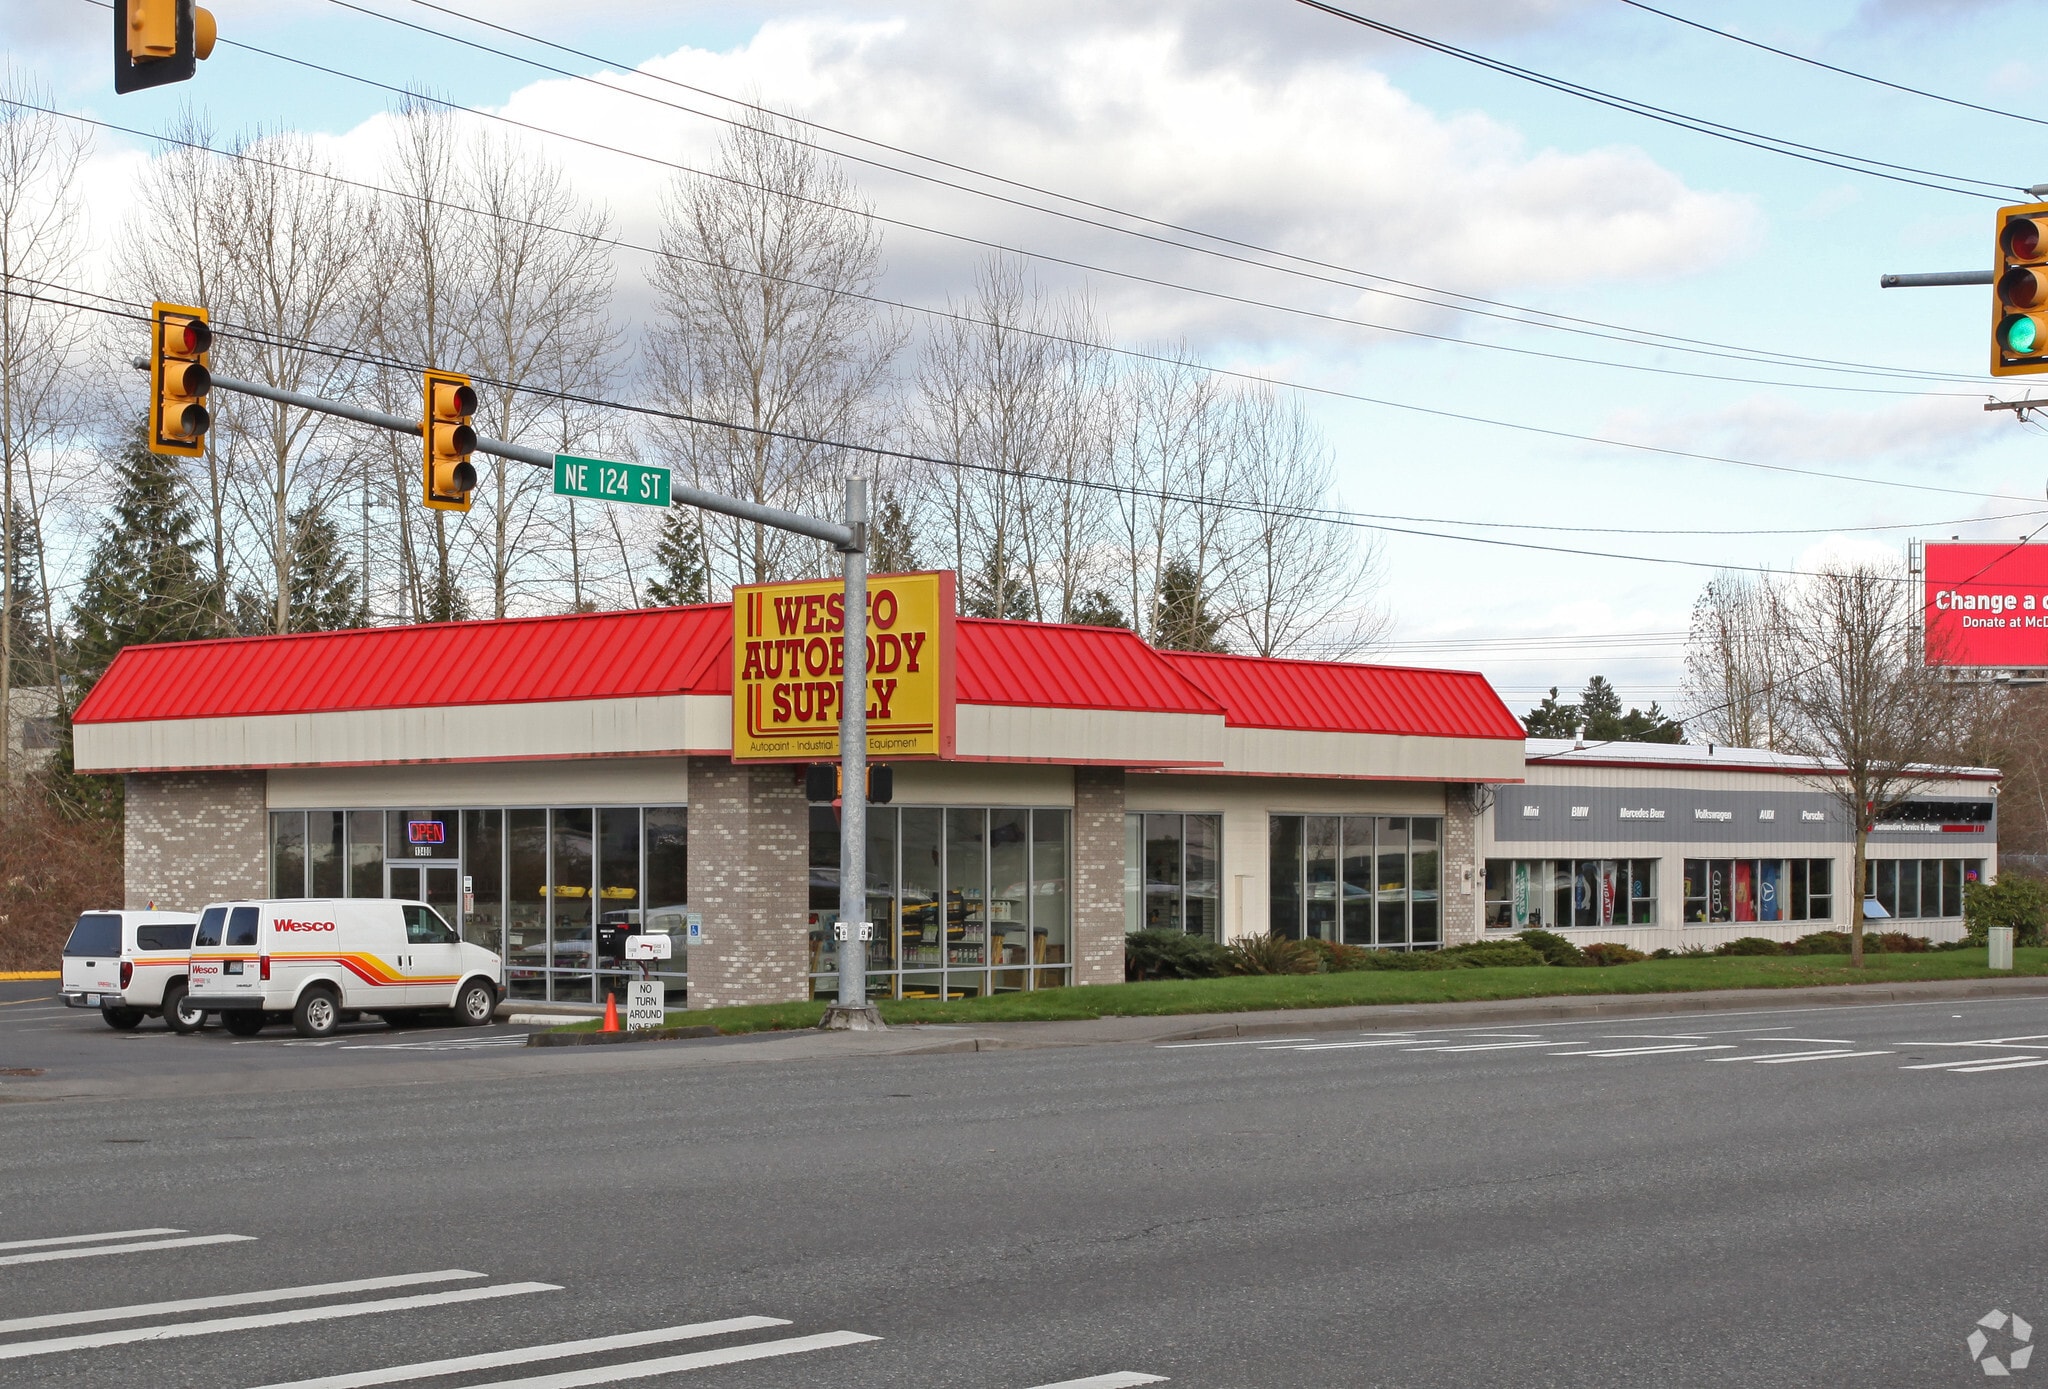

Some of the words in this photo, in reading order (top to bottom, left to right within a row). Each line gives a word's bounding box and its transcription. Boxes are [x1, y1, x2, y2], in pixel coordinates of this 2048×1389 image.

[565, 463, 588, 491] NE
[600, 467, 628, 495] 124
[640, 472, 661, 499] ST
[1936, 590, 2017, 614] Change
[2023, 594, 2035, 610] a
[774, 589, 898, 635] WESO
[1963, 616, 2005, 628] Donate
[2010, 616, 2021, 628] at
[750, 741, 790, 753] Autopaint
[797, 739, 833, 750] Industrial
[870, 737, 917, 749] Equipment
[1523, 806, 1540, 817] Mini
[1571, 806, 1590, 817] BMW
[1620, 807, 1649, 818] Mercedes
[1650, 808, 1665, 819] Benz
[1695, 809, 1732, 821] Volkswagen
[1802, 810, 1825, 821] Porsche
[410, 823, 442, 842] OPEN
[1874, 823, 1901, 831] Automotive
[1902, 823, 1920, 831] Service
[1925, 823, 1940, 833] Repair
[274, 919, 335, 932] Wesco
[192, 965, 218, 974] Wesco
[640, 985, 652, 993] NO
[635, 997, 656, 1006] TURN
[629, 1009, 662, 1019] AROUND
